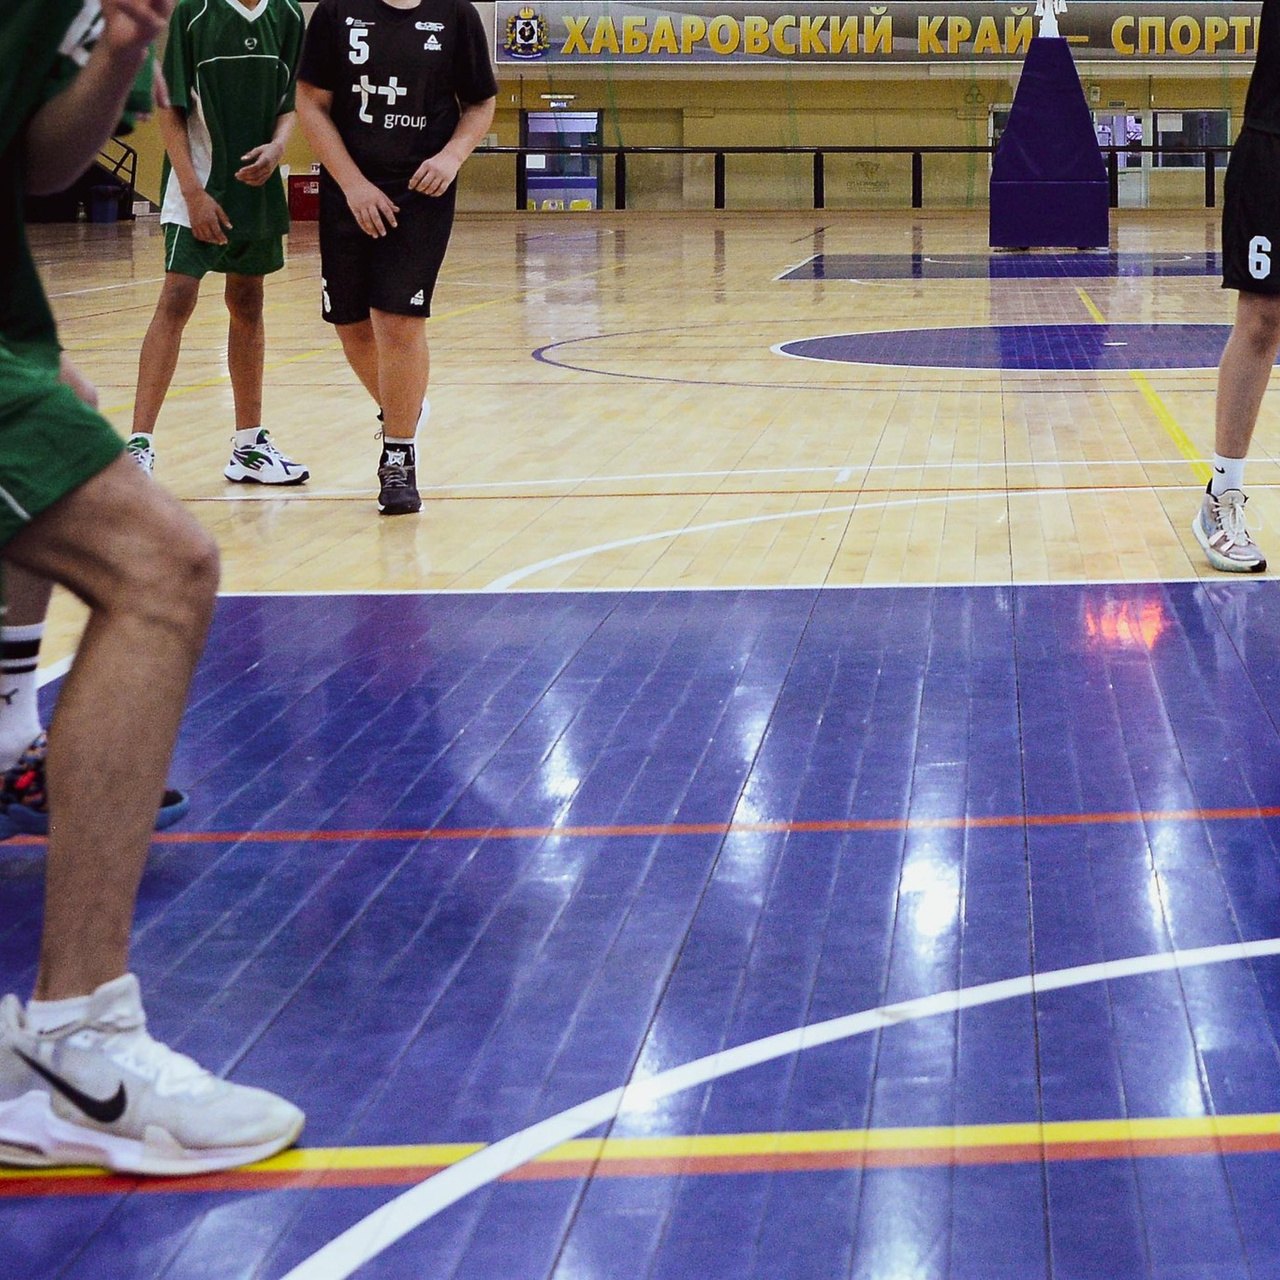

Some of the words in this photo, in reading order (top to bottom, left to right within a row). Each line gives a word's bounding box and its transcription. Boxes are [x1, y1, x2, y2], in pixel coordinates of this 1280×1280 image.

[349, 28, 369, 64] 5
[560, 6, 893, 54] ХАБАРОВСКИЙ
[917, 6, 1033, 54] КРАЙ
[384, 113, 427, 130] group
[1249, 235, 1272, 280] 6
